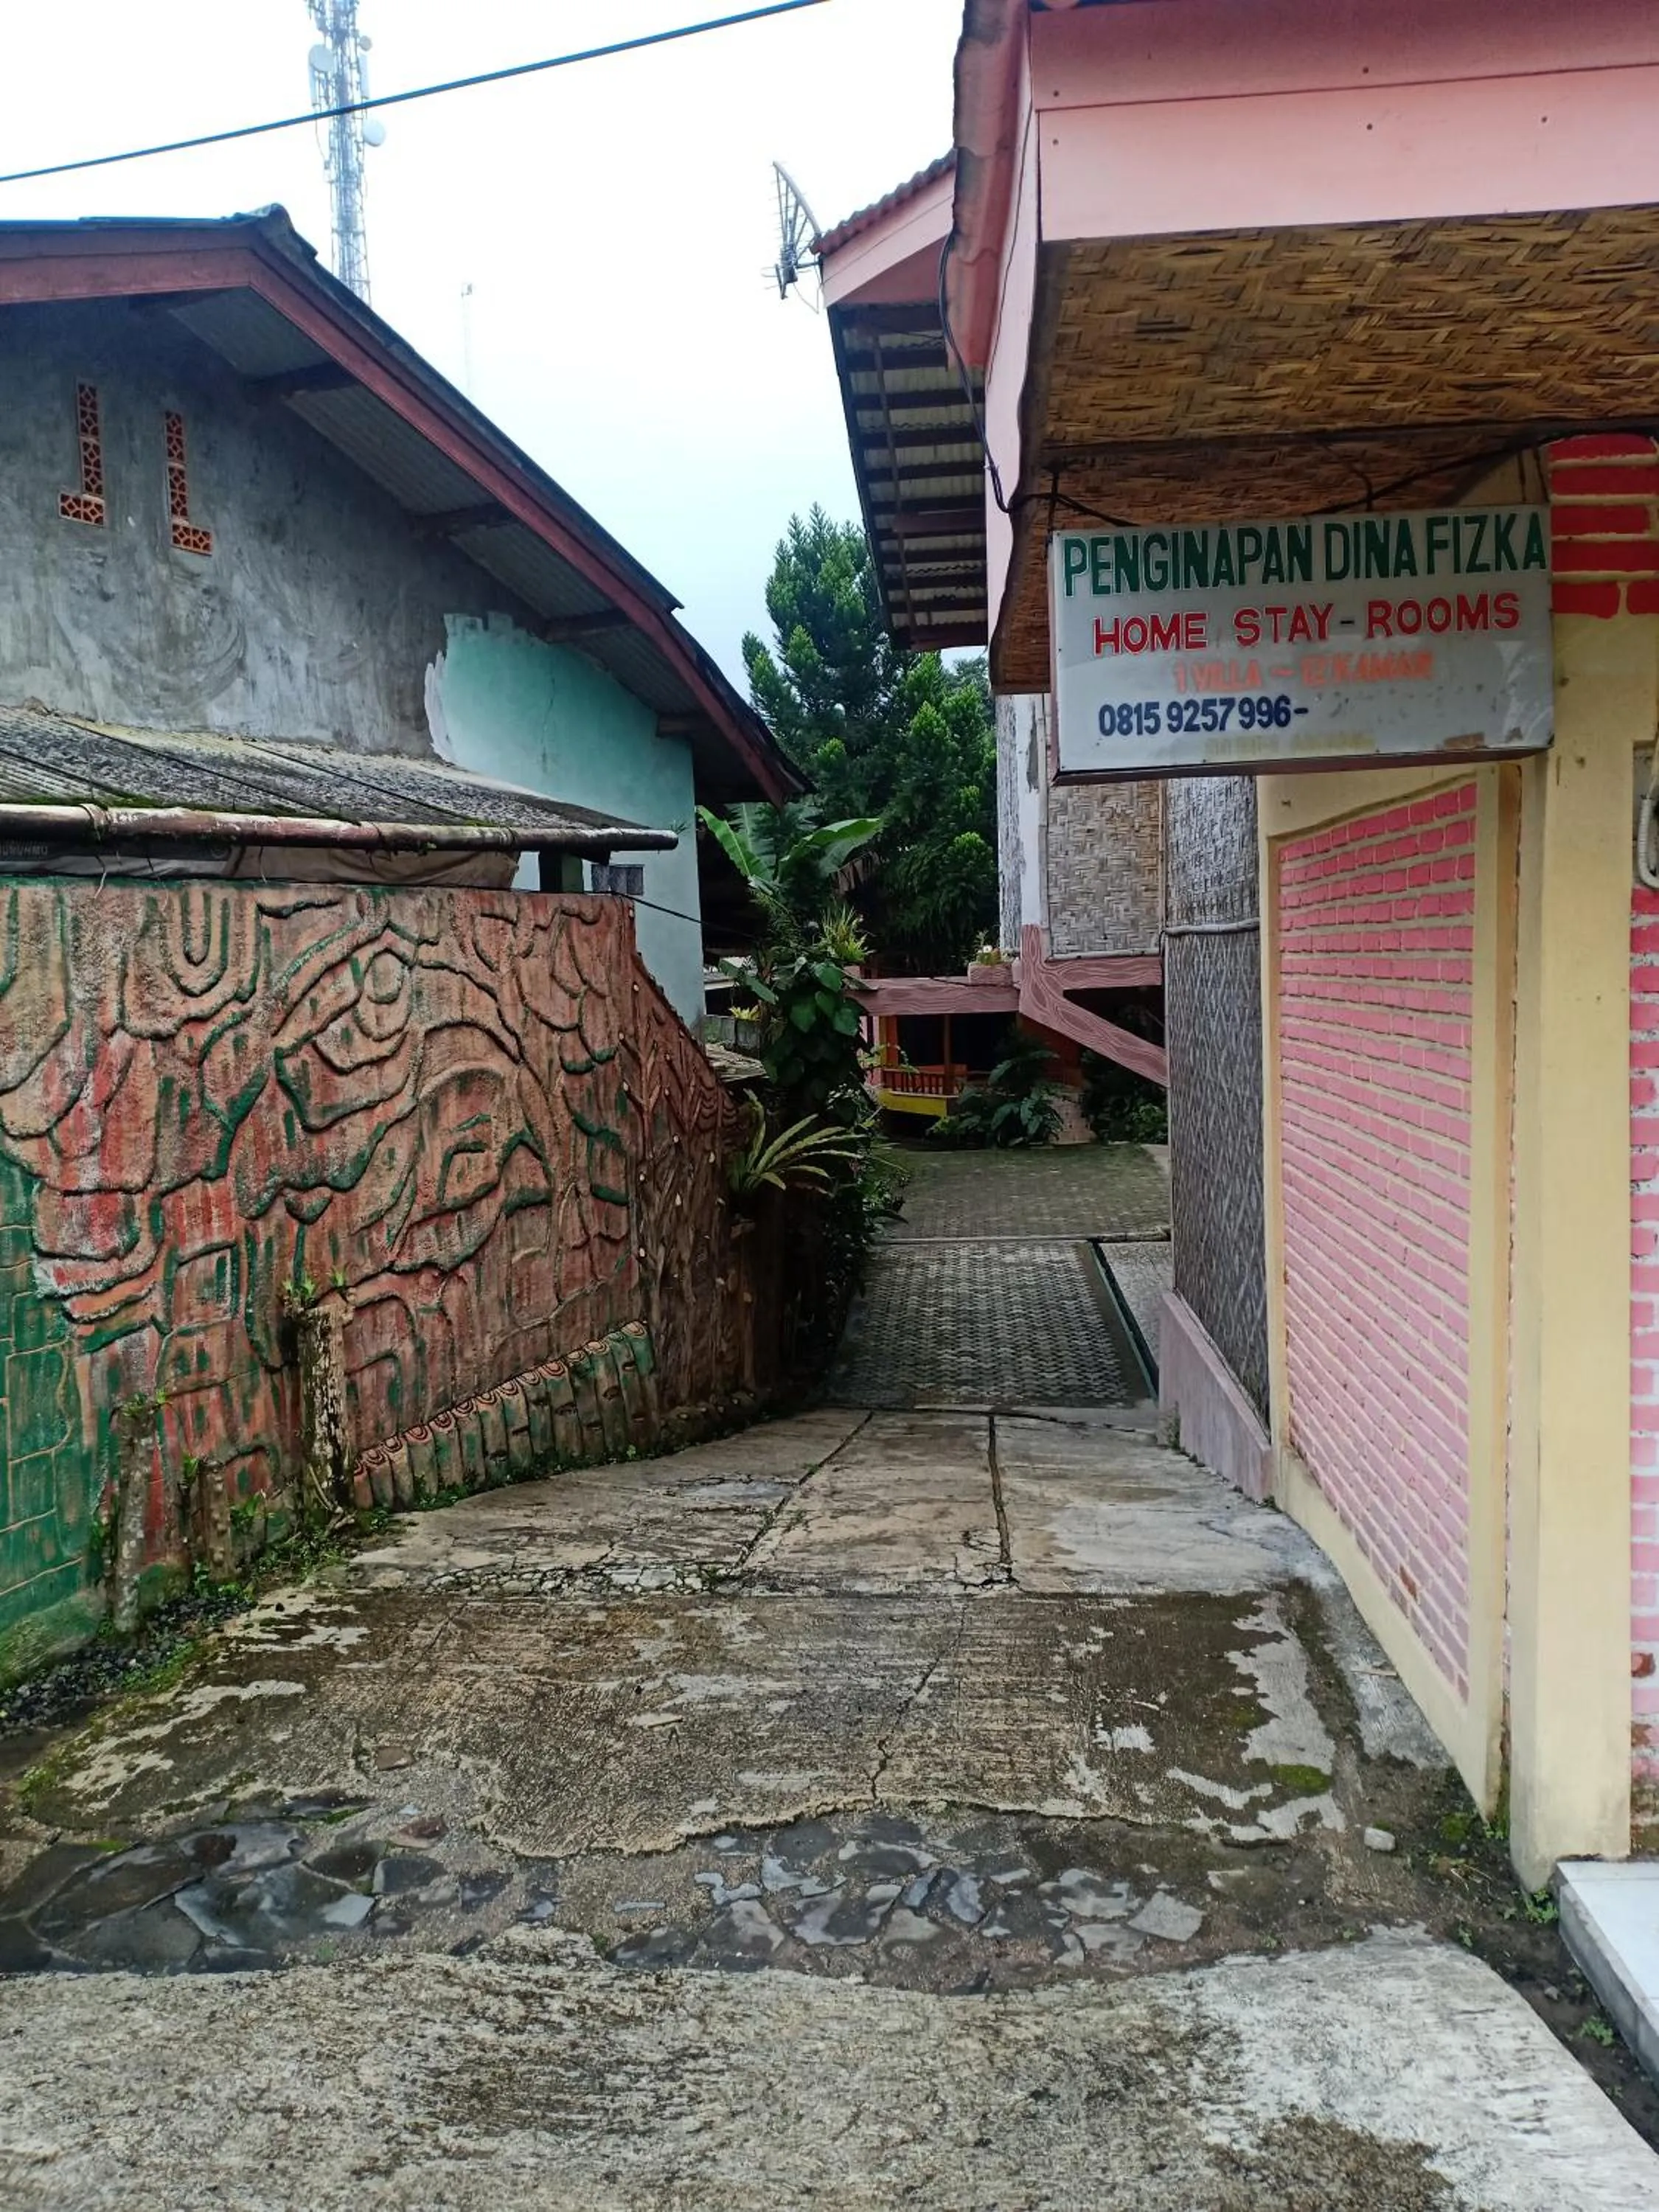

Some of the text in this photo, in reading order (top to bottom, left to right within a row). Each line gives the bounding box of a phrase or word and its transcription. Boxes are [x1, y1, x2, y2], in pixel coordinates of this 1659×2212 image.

[1063, 512, 1547, 597] PENGINAPAN DINA FIZKA
[1093, 611, 1208, 655] HOME
[1233, 602, 1334, 648] STAY
[1366, 592, 1520, 639] ROOMS
[1191, 658, 1262, 692] VILLA
[1099, 701, 1161, 736] 0815
